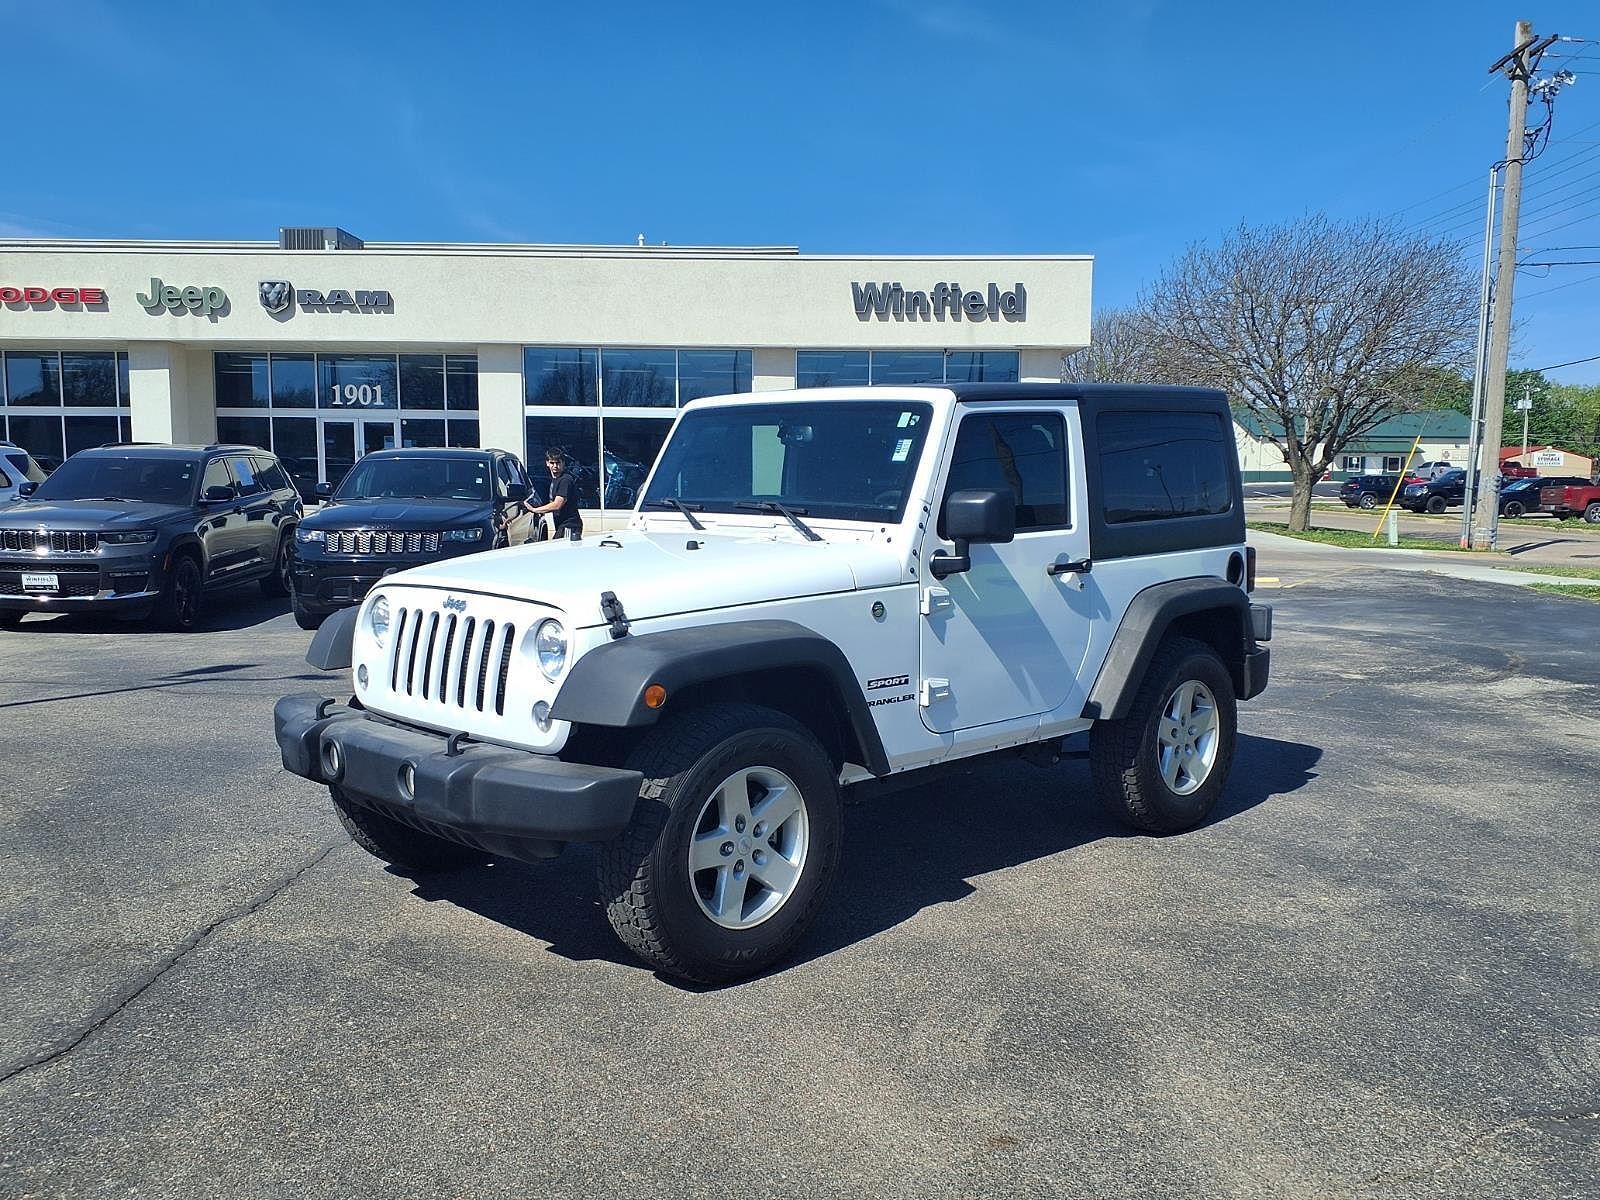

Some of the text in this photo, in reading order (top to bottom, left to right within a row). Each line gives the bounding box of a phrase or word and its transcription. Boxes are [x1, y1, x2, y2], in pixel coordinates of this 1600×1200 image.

[0, 287, 106, 304] ODGE
[136, 278, 226, 315] Jeep
[296, 289, 391, 307] RAM
[851, 281, 1026, 316] Winfield
[331, 384, 385, 406] 1901
[443, 595, 467, 613] Jeep
[868, 675, 909, 690] SPORT
[866, 694, 915, 706] RANGLER
